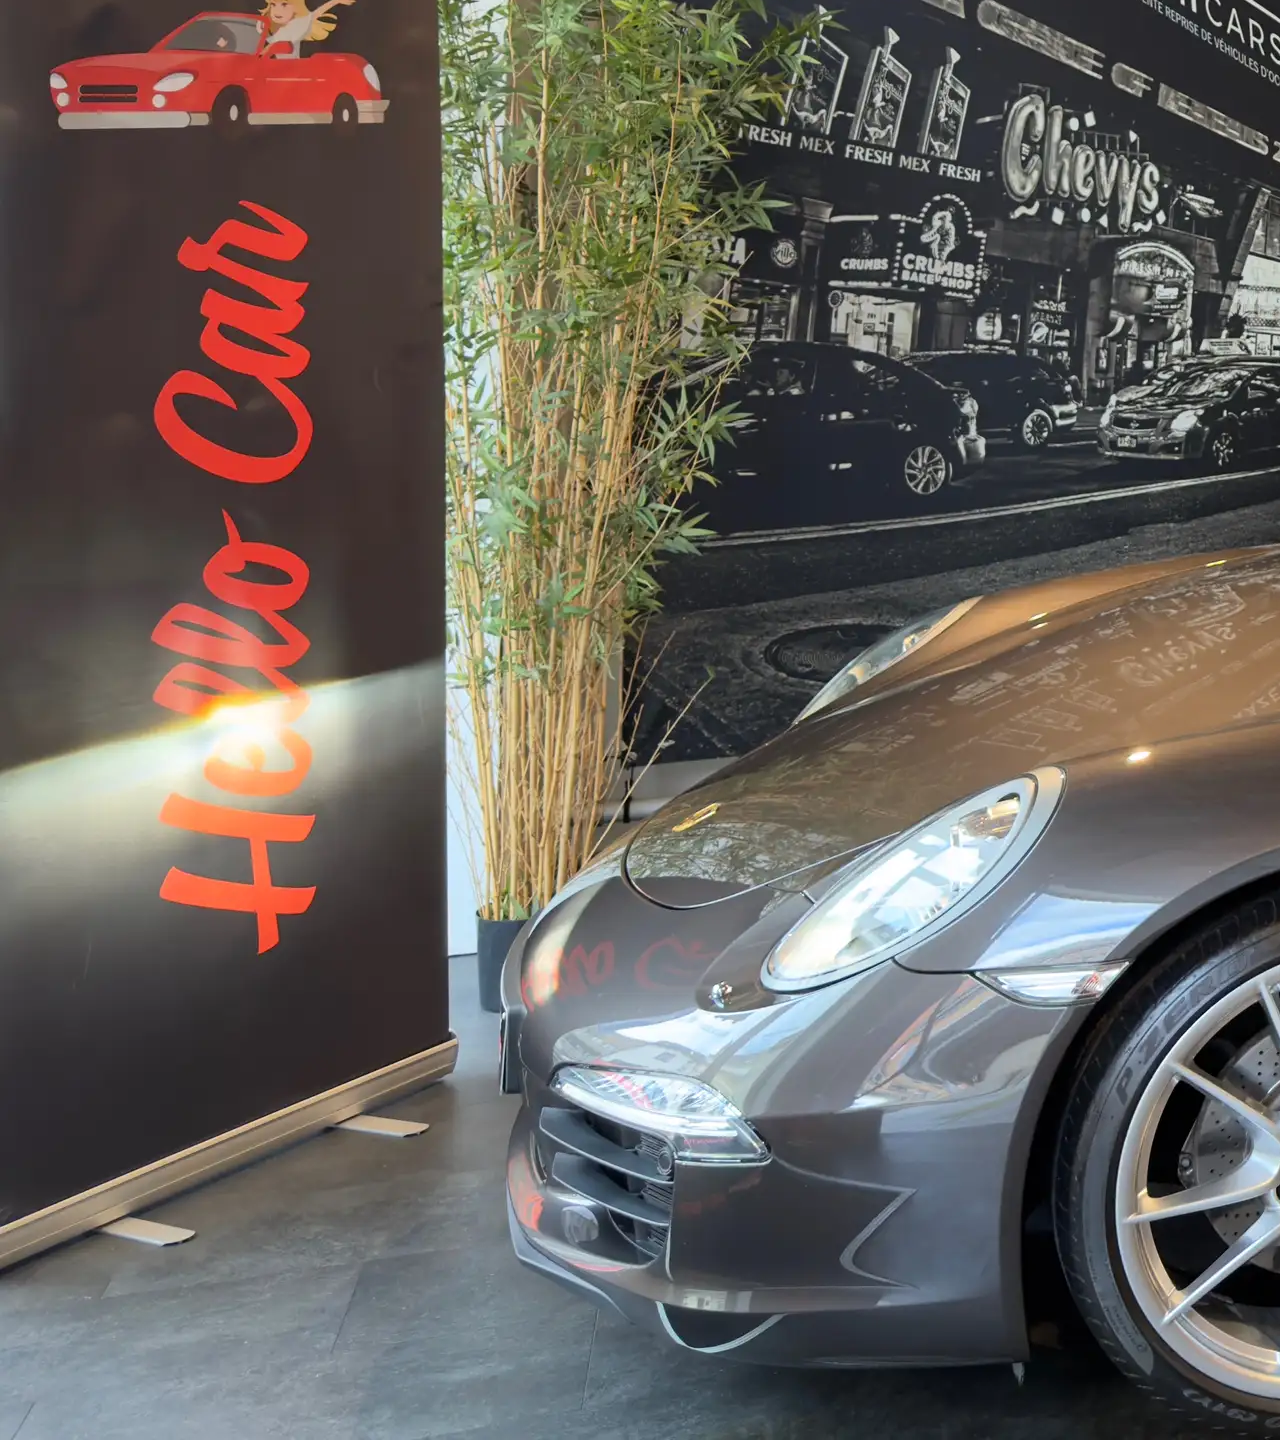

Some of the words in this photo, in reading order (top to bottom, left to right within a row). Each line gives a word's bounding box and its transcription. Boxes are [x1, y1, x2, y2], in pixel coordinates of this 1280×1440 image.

[1165, 5, 1199, 37] REPRISE
[1201, 28, 1213, 45] DE
[799, 135, 835, 155] MEX
[844, 144, 893, 166] FRESH
[899, 154, 930, 174] MEX
[938, 162, 981, 182] FRESH
[1002, 95, 1159, 231] Chevys
[840, 258, 888, 271] CRUMBS
[902, 253, 975, 279] CRUMBS
[153, 198, 314, 485] Car
[150, 507, 317, 955] Hello
